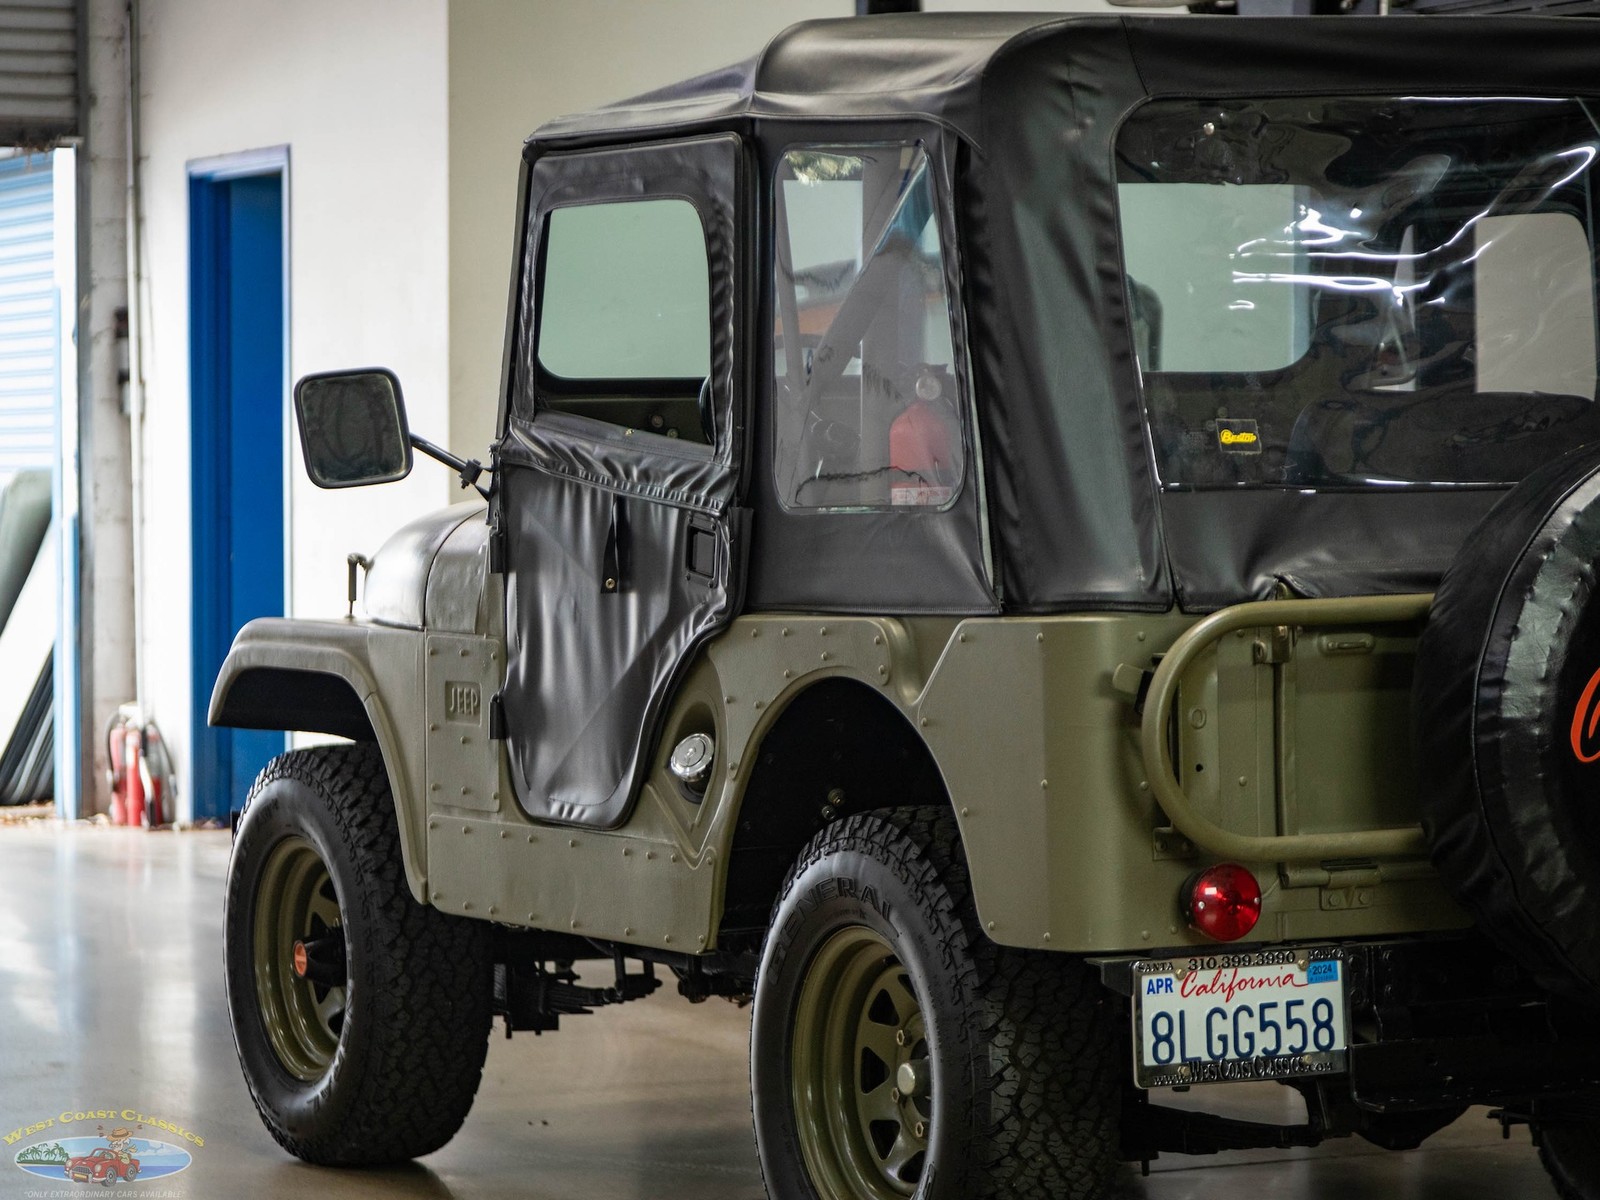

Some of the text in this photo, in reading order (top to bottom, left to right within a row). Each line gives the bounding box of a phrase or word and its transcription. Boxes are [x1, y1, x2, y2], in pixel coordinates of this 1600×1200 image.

[449, 687, 478, 716] JEEP
[767, 876, 900, 985] GENERAL
[1137, 961, 1174, 973] SANTA
[1187, 950, 1296, 972] 310.399.3990
[1312, 964, 1333, 976] 2024
[1146, 966, 1308, 1003] APR California
[1151, 997, 1336, 1065] 8LGG558
